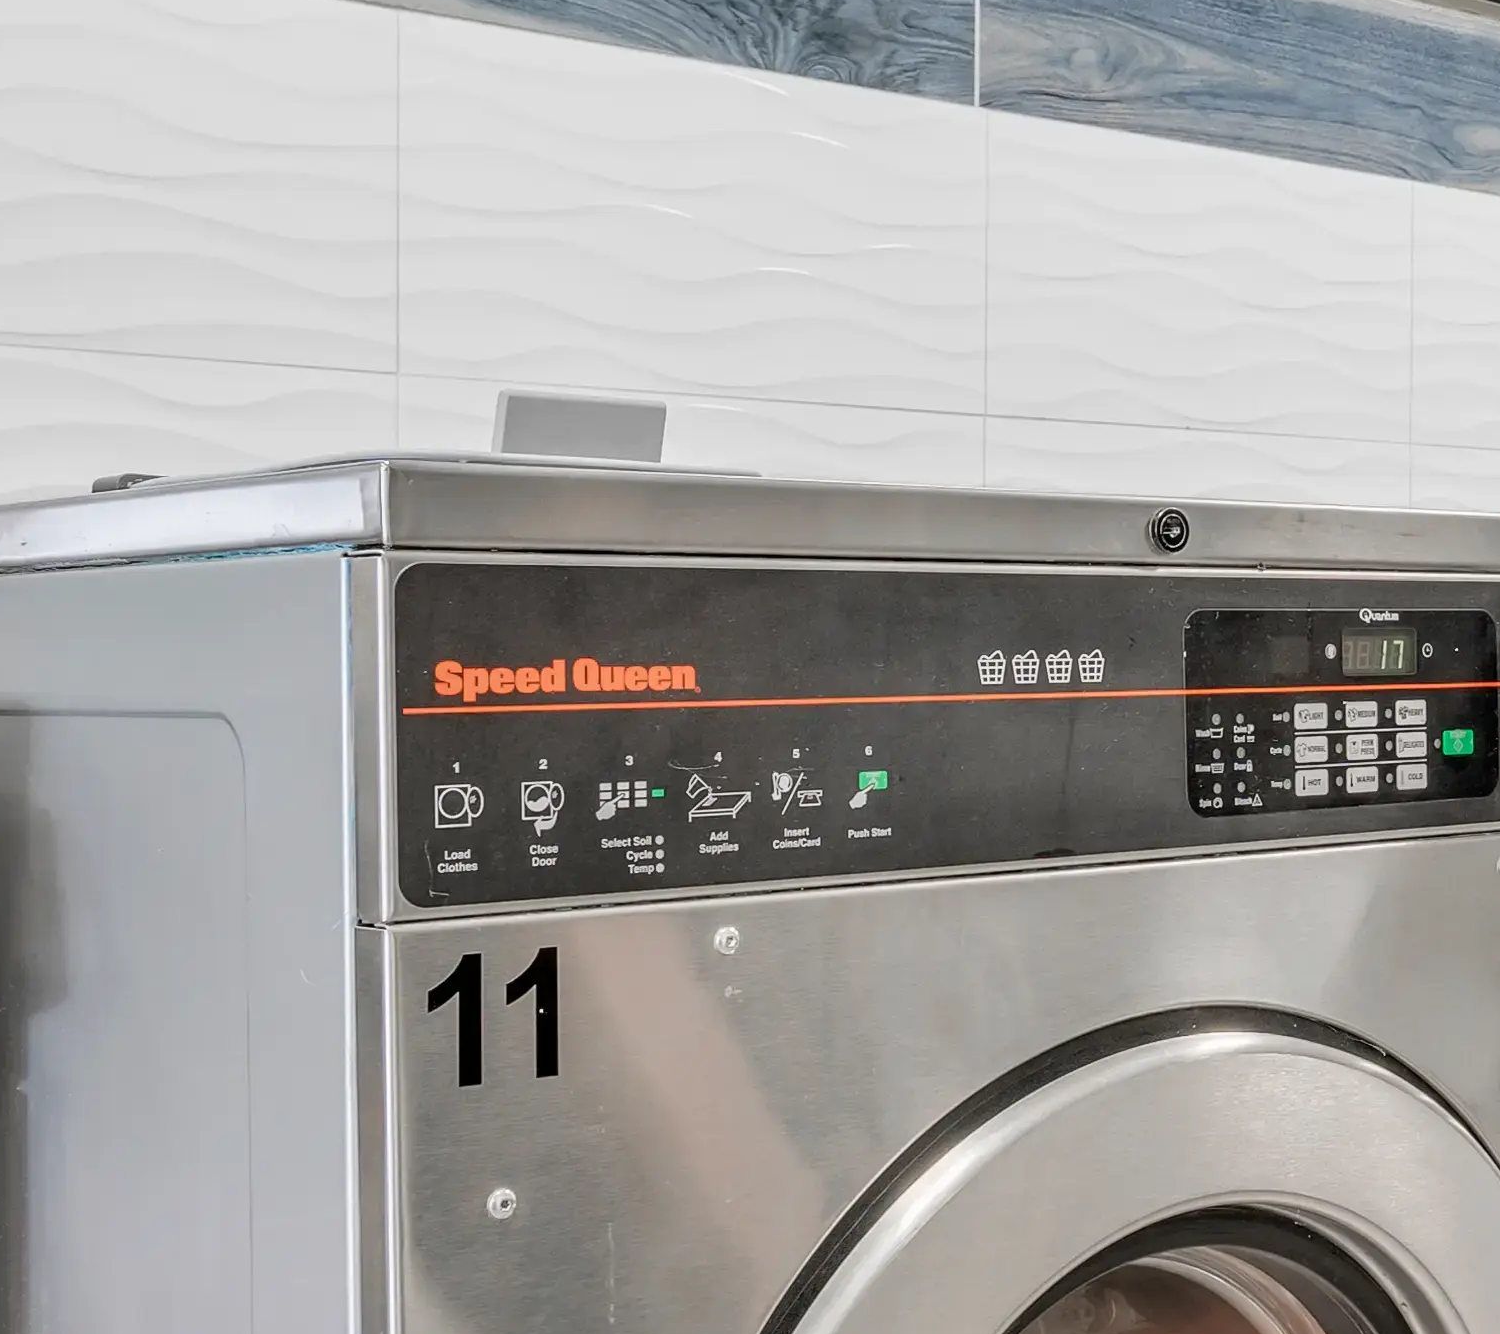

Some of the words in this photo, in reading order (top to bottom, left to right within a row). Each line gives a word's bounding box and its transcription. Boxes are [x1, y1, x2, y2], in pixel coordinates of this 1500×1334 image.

[1381, 640, 1404, 669] 17
[434, 659, 566, 702] Speed
[572, 657, 696, 694] Queen
[792, 749, 800, 759] 5
[865, 746, 873, 756] 6
[625, 755, 633, 765] 3
[714, 752, 722, 762] 4
[452, 761, 460, 773] 1
[538, 758, 548, 769] 2
[1307, 778, 1322, 786] HOT
[1356, 775, 1376, 783] WARM
[1408, 773, 1423, 781] COLD
[710, 830, 729, 841] Add
[784, 827, 810, 837] Insert
[848, 828, 870, 838] Push
[871, 827, 892, 837] Start
[601, 837, 631, 848] Select
[633, 835, 652, 846] Soil
[772, 837, 821, 850] Coins/Card
[444, 848, 471, 860] Load
[529, 844, 559, 856] Close
[699, 843, 739, 855] Supplies
[626, 850, 653, 861] Cycle
[437, 861, 478, 873] Clothes
[531, 857, 557, 867] Door
[628, 864, 654, 874] Temp
[427, 946, 560, 1088] 11
